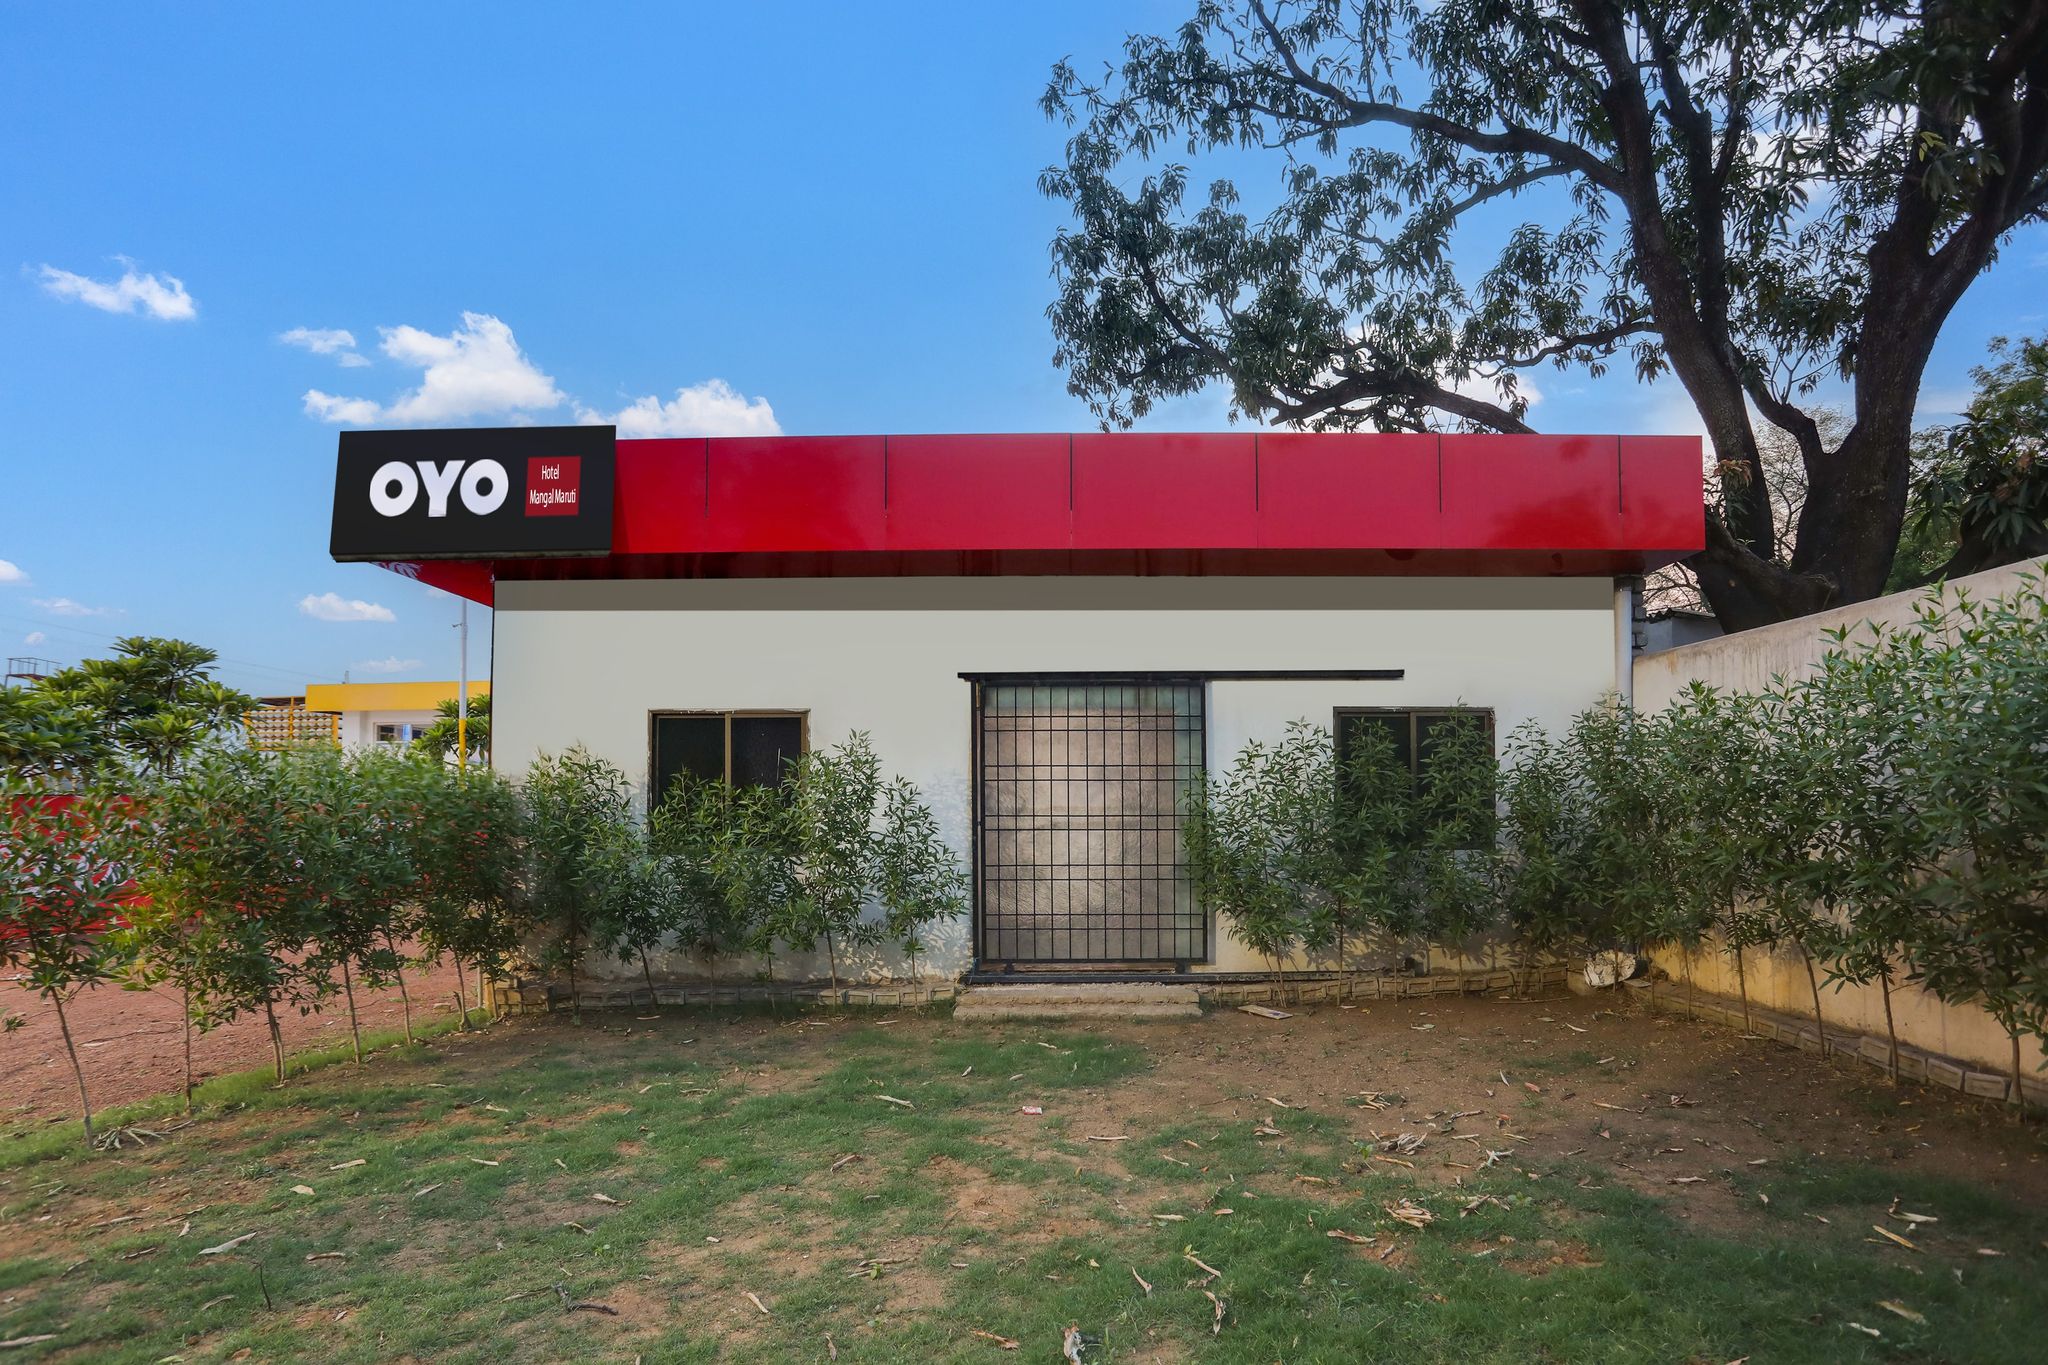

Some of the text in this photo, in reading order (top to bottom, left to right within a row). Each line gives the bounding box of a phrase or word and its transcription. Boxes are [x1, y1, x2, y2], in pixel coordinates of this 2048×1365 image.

[541, 464, 560, 480] Hotel
[369, 459, 509, 518] OYO
[529, 488, 577, 508] Mangal Maruti
